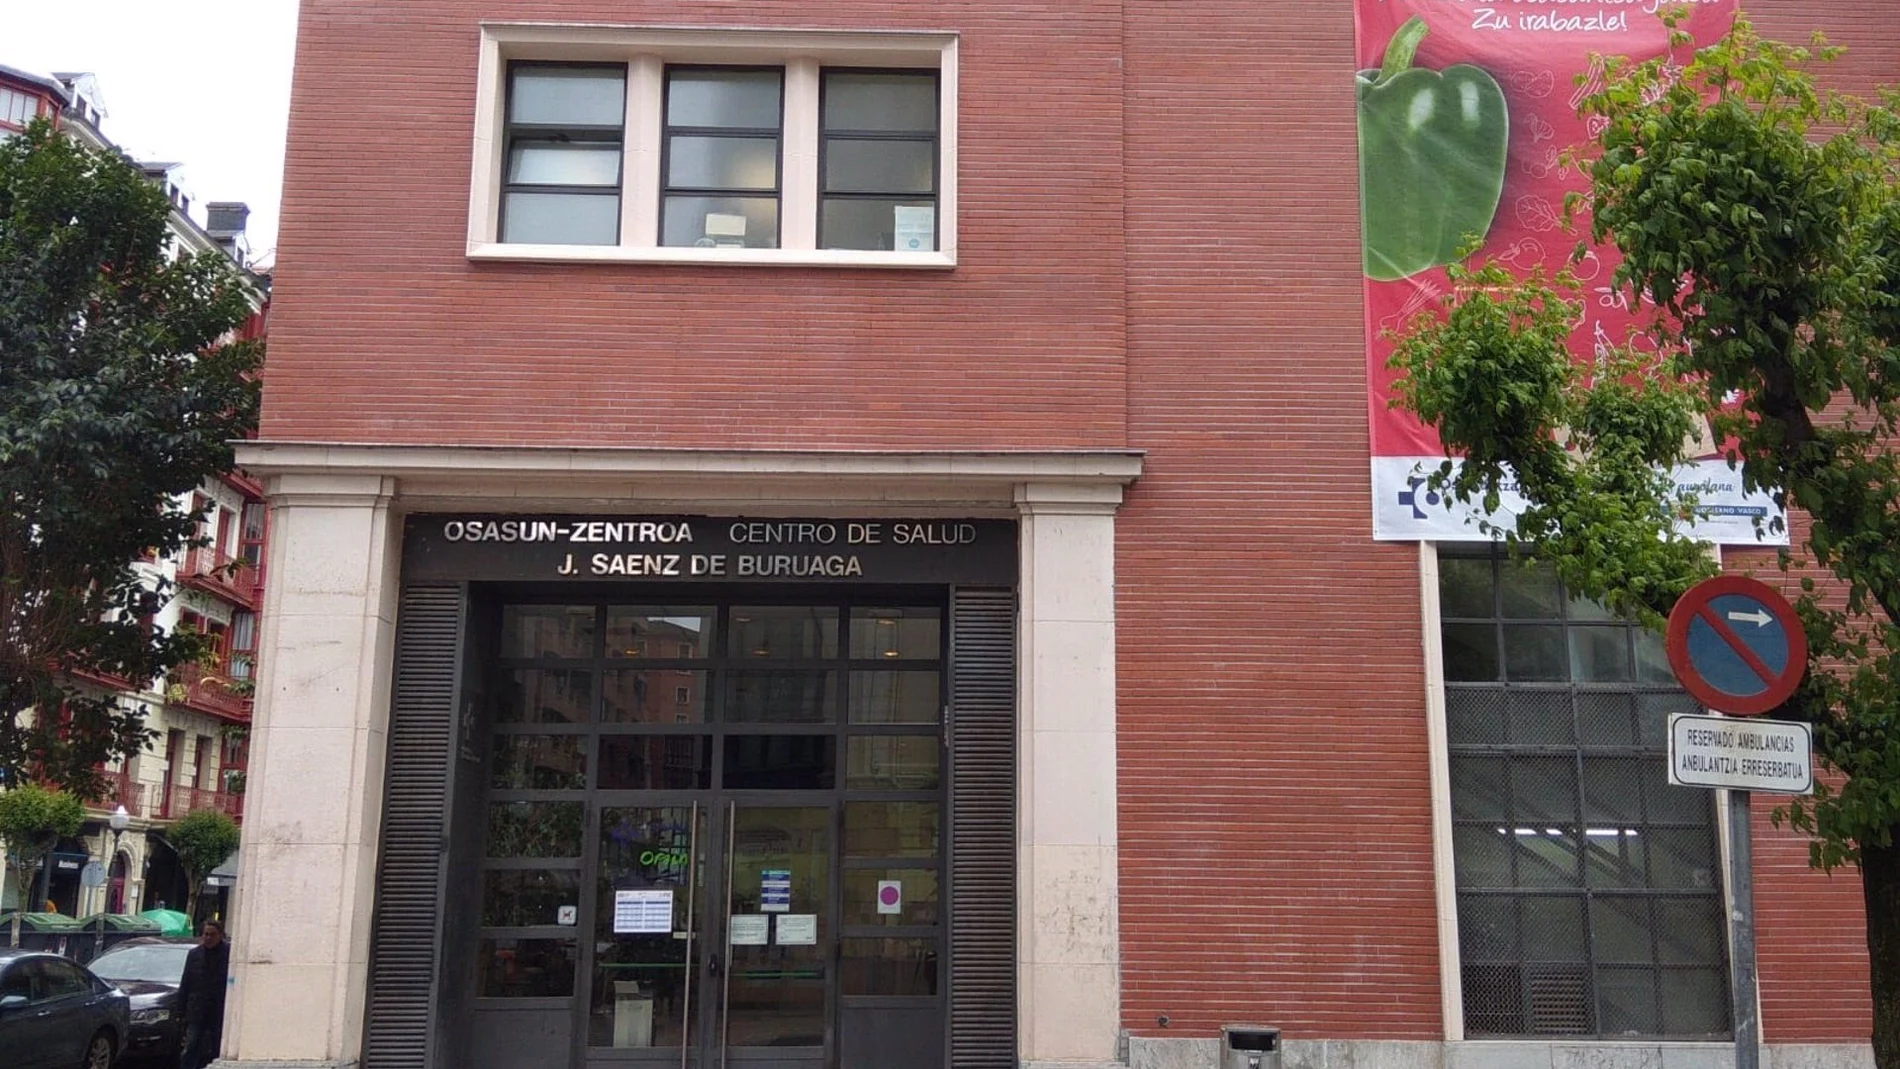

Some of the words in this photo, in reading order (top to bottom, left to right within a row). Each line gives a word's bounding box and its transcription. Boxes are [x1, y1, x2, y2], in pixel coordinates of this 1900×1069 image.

[1471, 8, 1511, 30] Zu
[1519, 10, 1628, 32] irabazle!
[444, 521, 694, 543] OSASUN-ZENTROA
[729, 523, 837, 544] CENTRO
[847, 524, 881, 544] DE
[892, 524, 976, 544] SALUD
[557, 554, 579, 575] J.
[591, 553, 680, 575] SAENZ
[691, 555, 726, 575] DE
[737, 555, 863, 576] BURUAGA
[1687, 729, 1734, 748] RESERVADO
[1737, 732, 1795, 752] AMBULANCIAS
[1681, 754, 1738, 774] ANBULANTZIA
[1741, 758, 1803, 779] ERRESERBATUA
